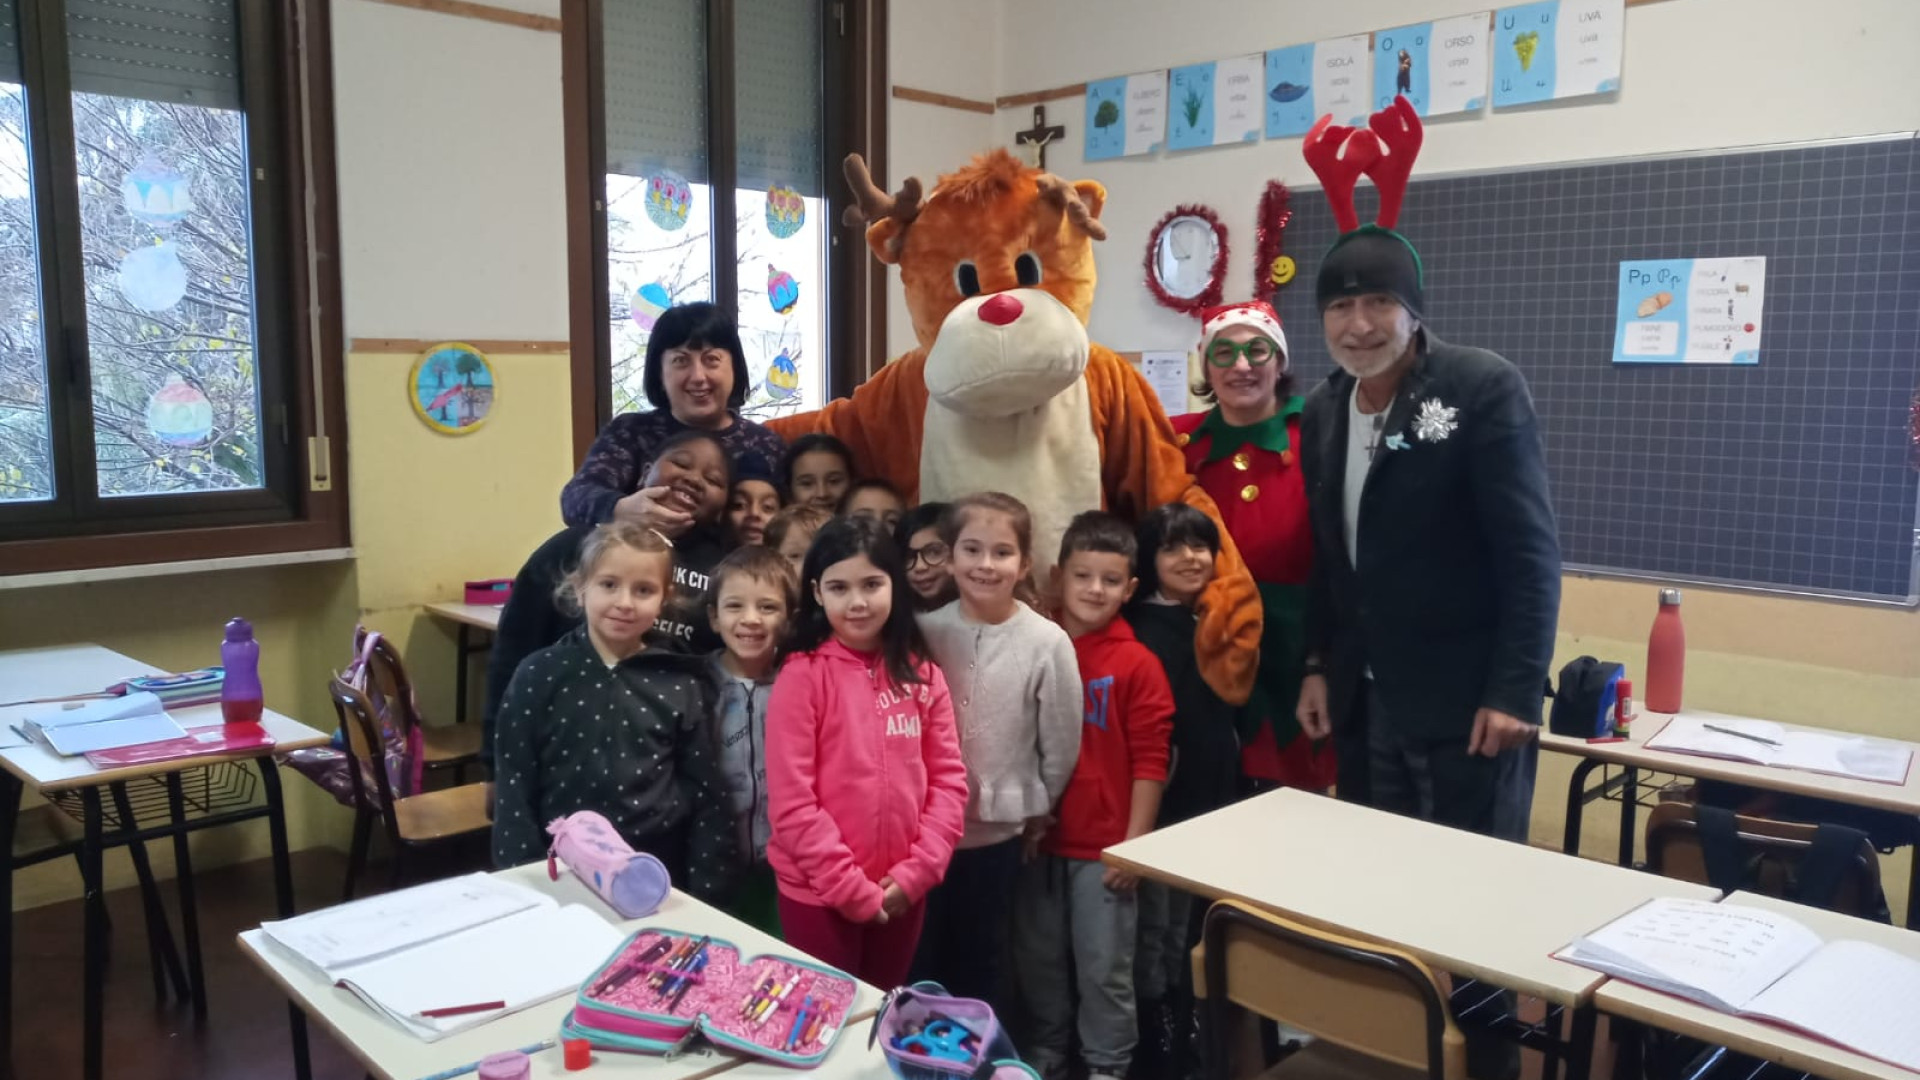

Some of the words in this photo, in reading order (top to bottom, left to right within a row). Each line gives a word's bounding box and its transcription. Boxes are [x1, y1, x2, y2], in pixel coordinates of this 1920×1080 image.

[1504, 15, 1515, 30] U
[1578, 11, 1601, 23] UVA
[1382, 37, 1393, 51] O
[1444, 35, 1475, 49] ORSO
[1629, 269, 1651, 285] Pp
